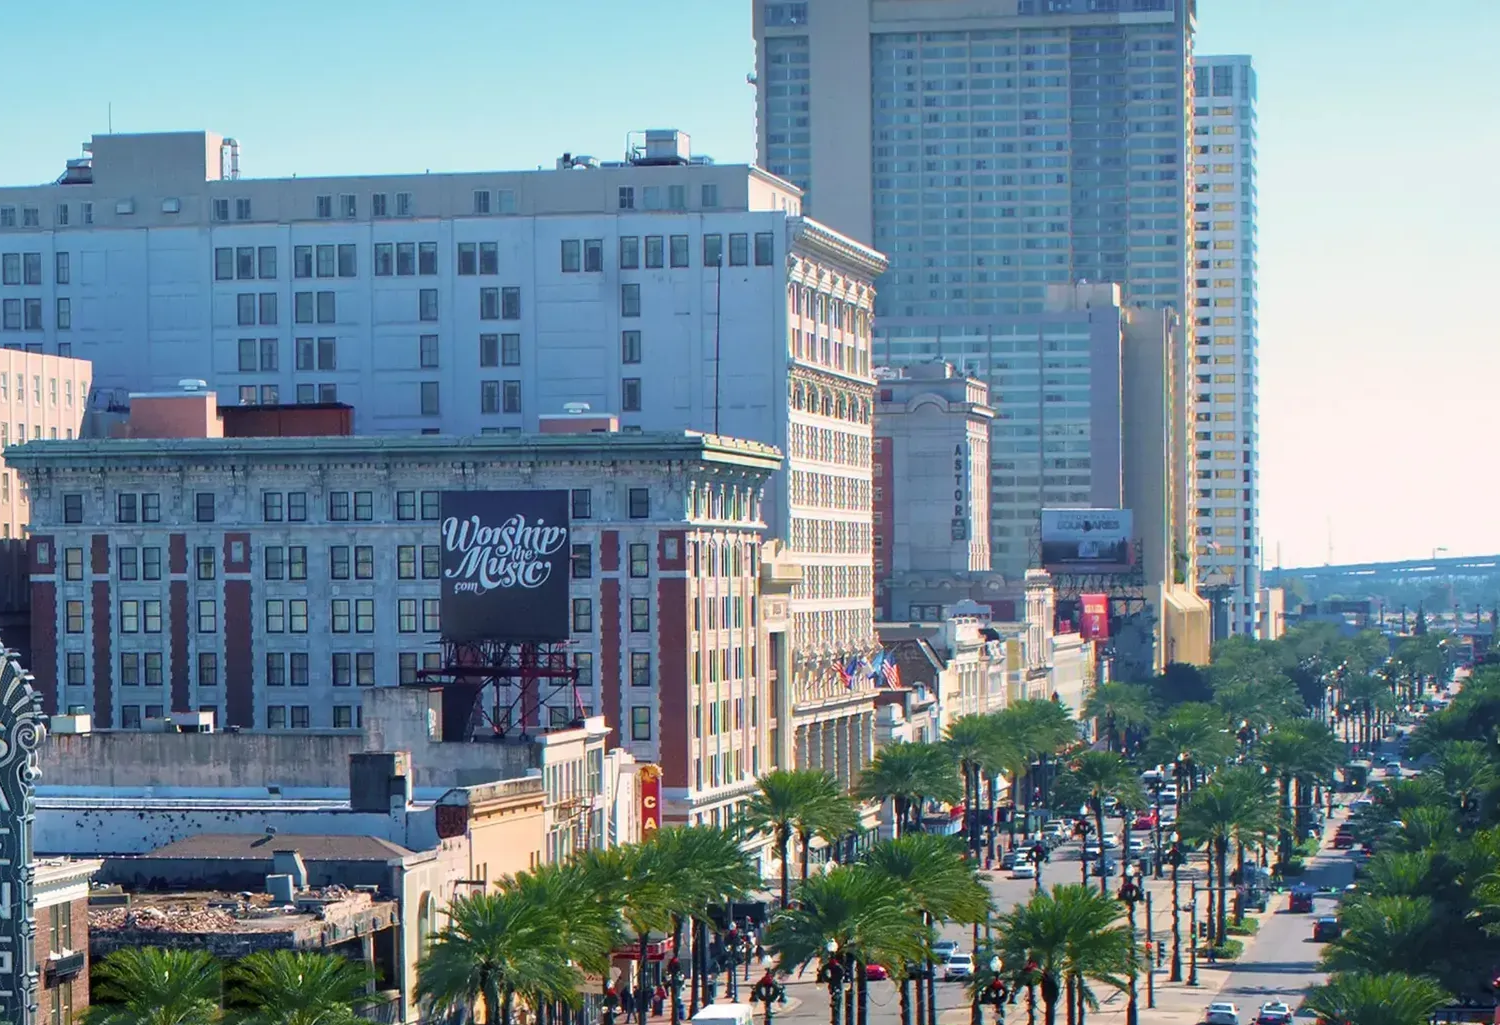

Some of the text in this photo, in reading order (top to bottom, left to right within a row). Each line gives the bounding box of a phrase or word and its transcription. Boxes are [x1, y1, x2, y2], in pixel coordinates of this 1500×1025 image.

[953, 444, 963, 516] ASTOR
[442, 513, 567, 556] Worship
[512, 545, 537, 563] the
[444, 546, 551, 589] Music
